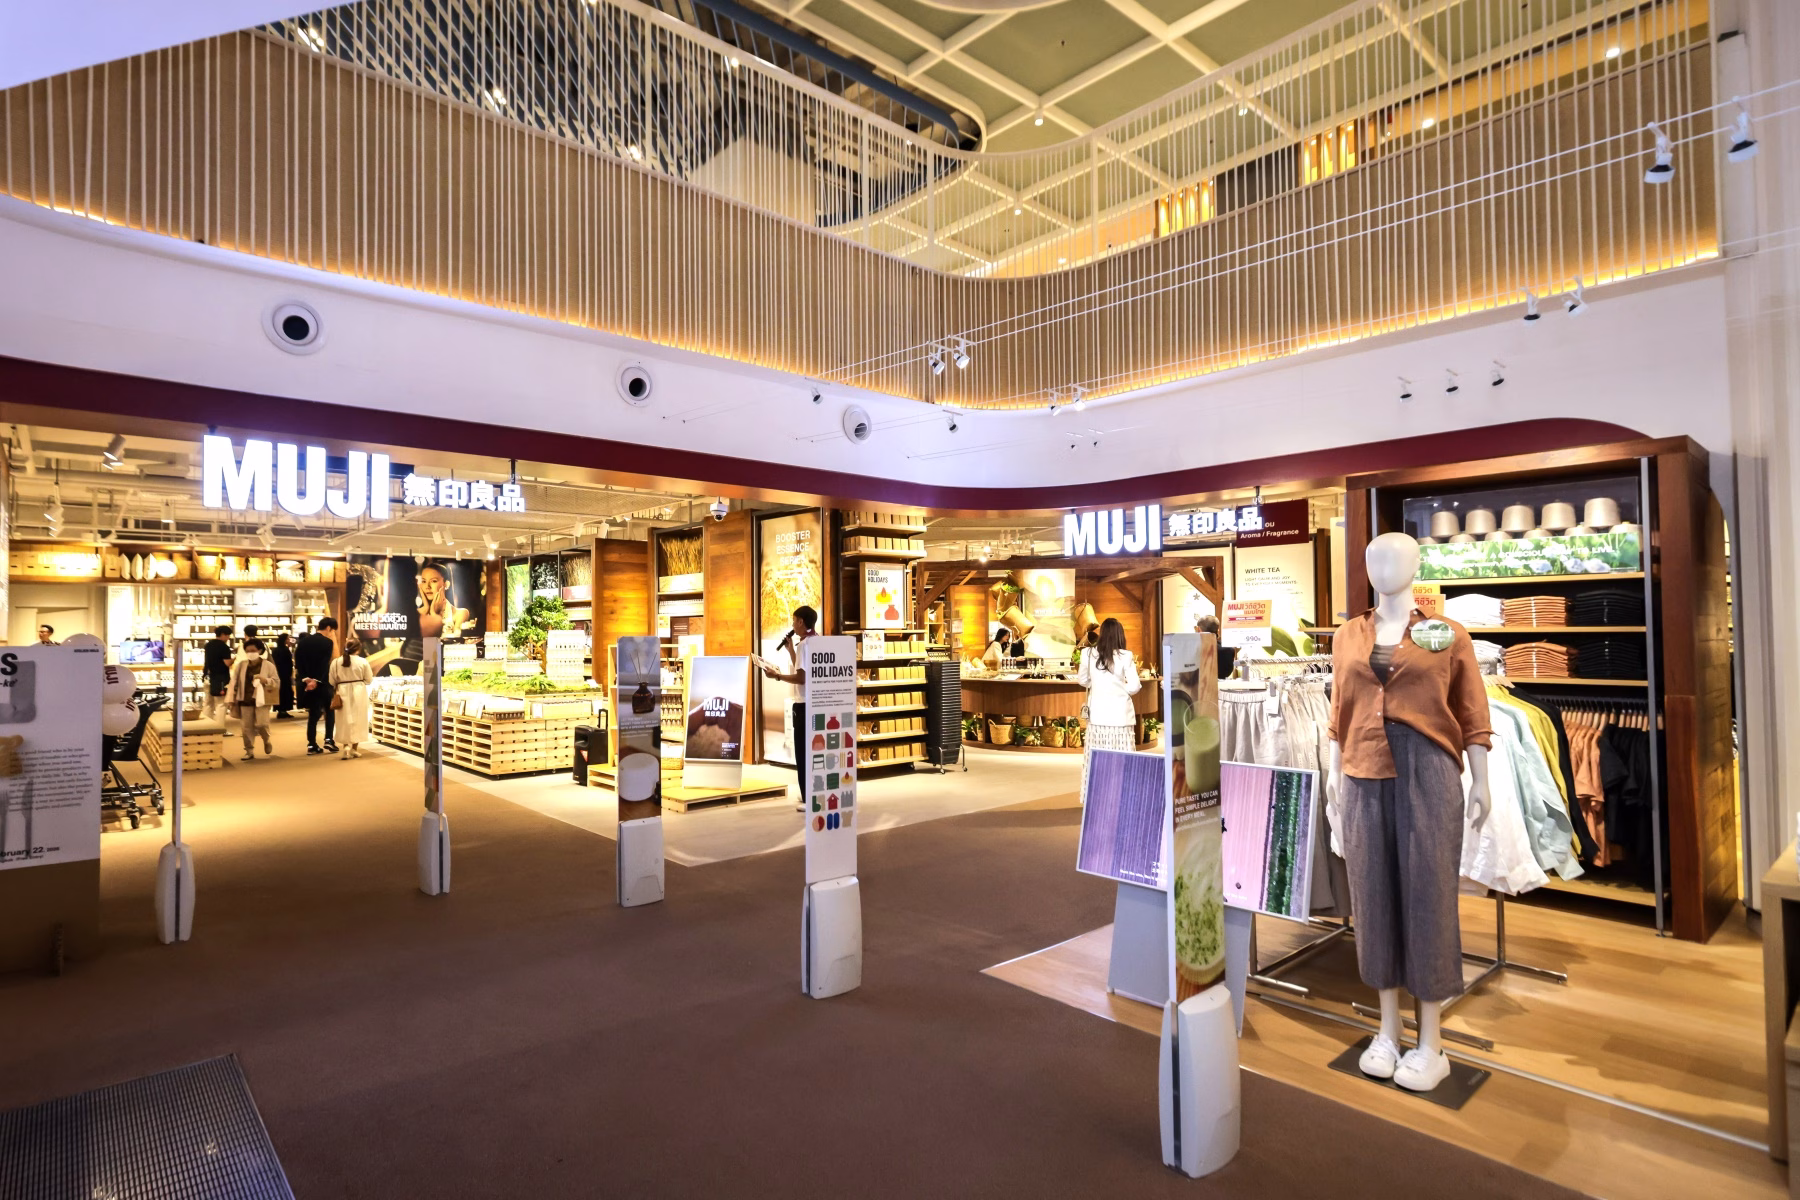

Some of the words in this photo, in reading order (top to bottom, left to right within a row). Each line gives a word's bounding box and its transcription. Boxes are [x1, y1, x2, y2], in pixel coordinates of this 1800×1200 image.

[203, 435, 390, 519] MUJI
[403, 473, 526, 513] 無印良品
[775, 530, 811, 543] BOOSTER
[1064, 504, 1163, 557] MUJI
[1168, 506, 1262, 537] 無印良品
[1266, 529, 1299, 538] Fragrance
[776, 542, 810, 555] ESSENCE
[867, 569, 880, 577] GOOD
[867, 576, 889, 584] HOLIDAYS
[1227, 603, 1244, 611] MUJI
[355, 612, 379, 623] MUJI
[811, 652, 836, 665] GOOD
[811, 665, 854, 678] HOLIDAYS
[703, 698, 730, 711] MUJI
[1175, 797, 1186, 805] PURE
[1186, 793, 1200, 802] TASTE
[1201, 791, 1210, 799] YOU
[1175, 806, 1185, 814] FEEL
[1186, 802, 1200, 812] SIMPLE
[1201, 799, 1218, 808] DELIGHT
[1180, 813, 1193, 822] EVERY
